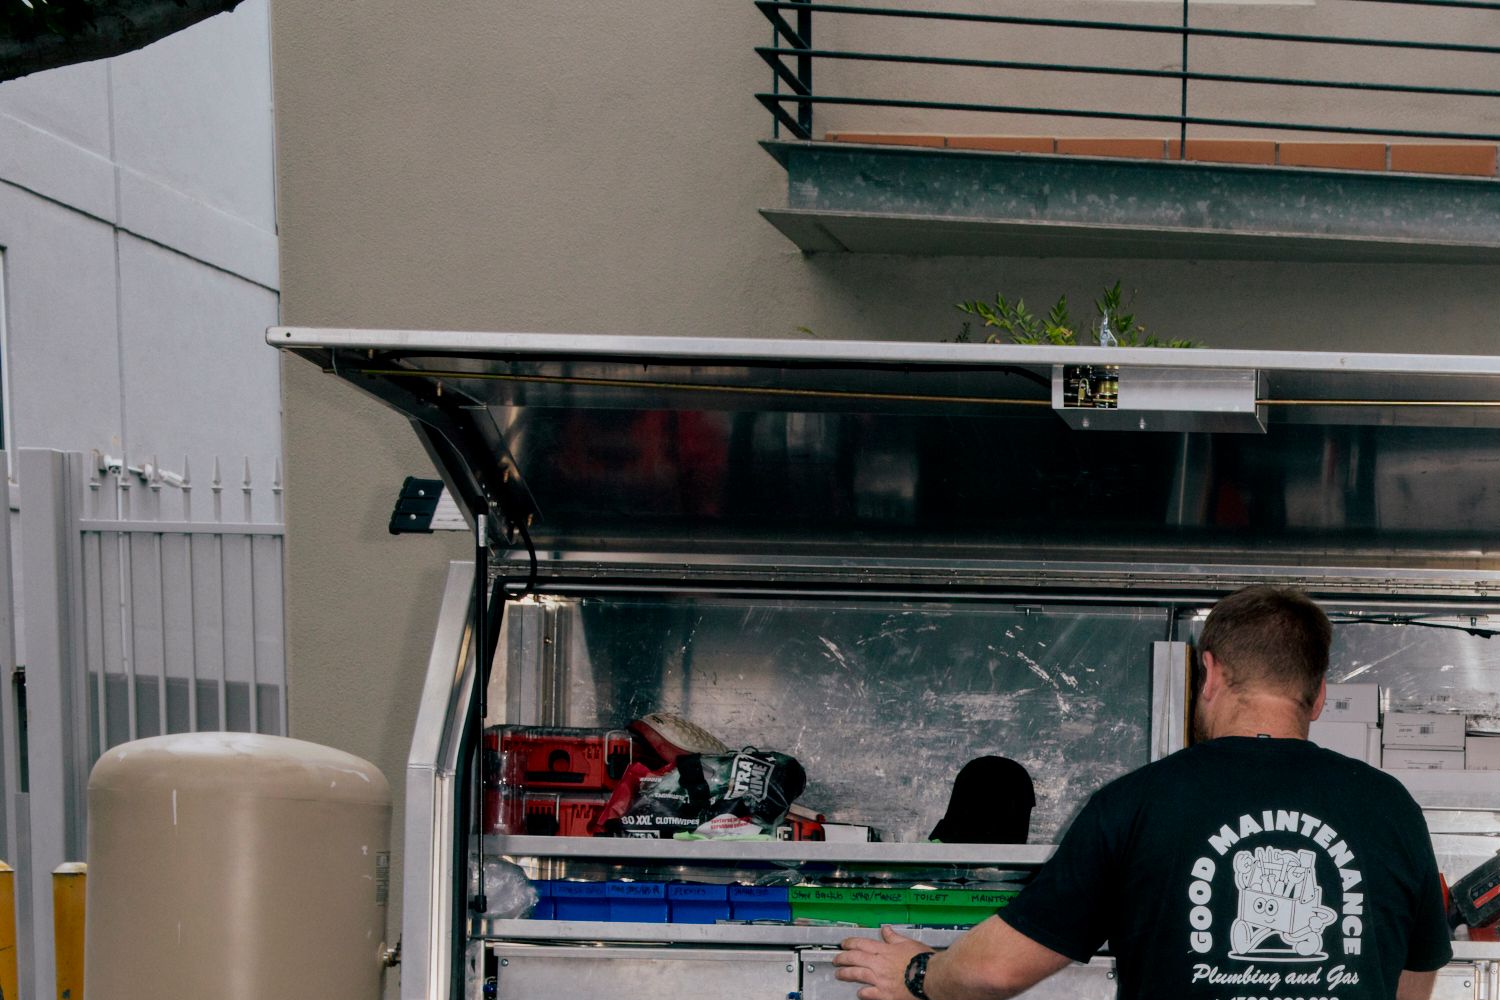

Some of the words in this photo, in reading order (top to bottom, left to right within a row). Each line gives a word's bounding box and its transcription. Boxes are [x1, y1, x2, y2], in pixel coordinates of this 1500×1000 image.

[655, 816, 700, 826] CLOTHWIPES
[1188, 857, 1216, 954] GOOD
[1208, 809, 1364, 956] MAINTENANCE
[913, 893, 949, 902] TOILET
[1191, 963, 1281, 991] Plumbing
[1284, 967, 1323, 985] and
[1326, 965, 1360, 991] Gas
